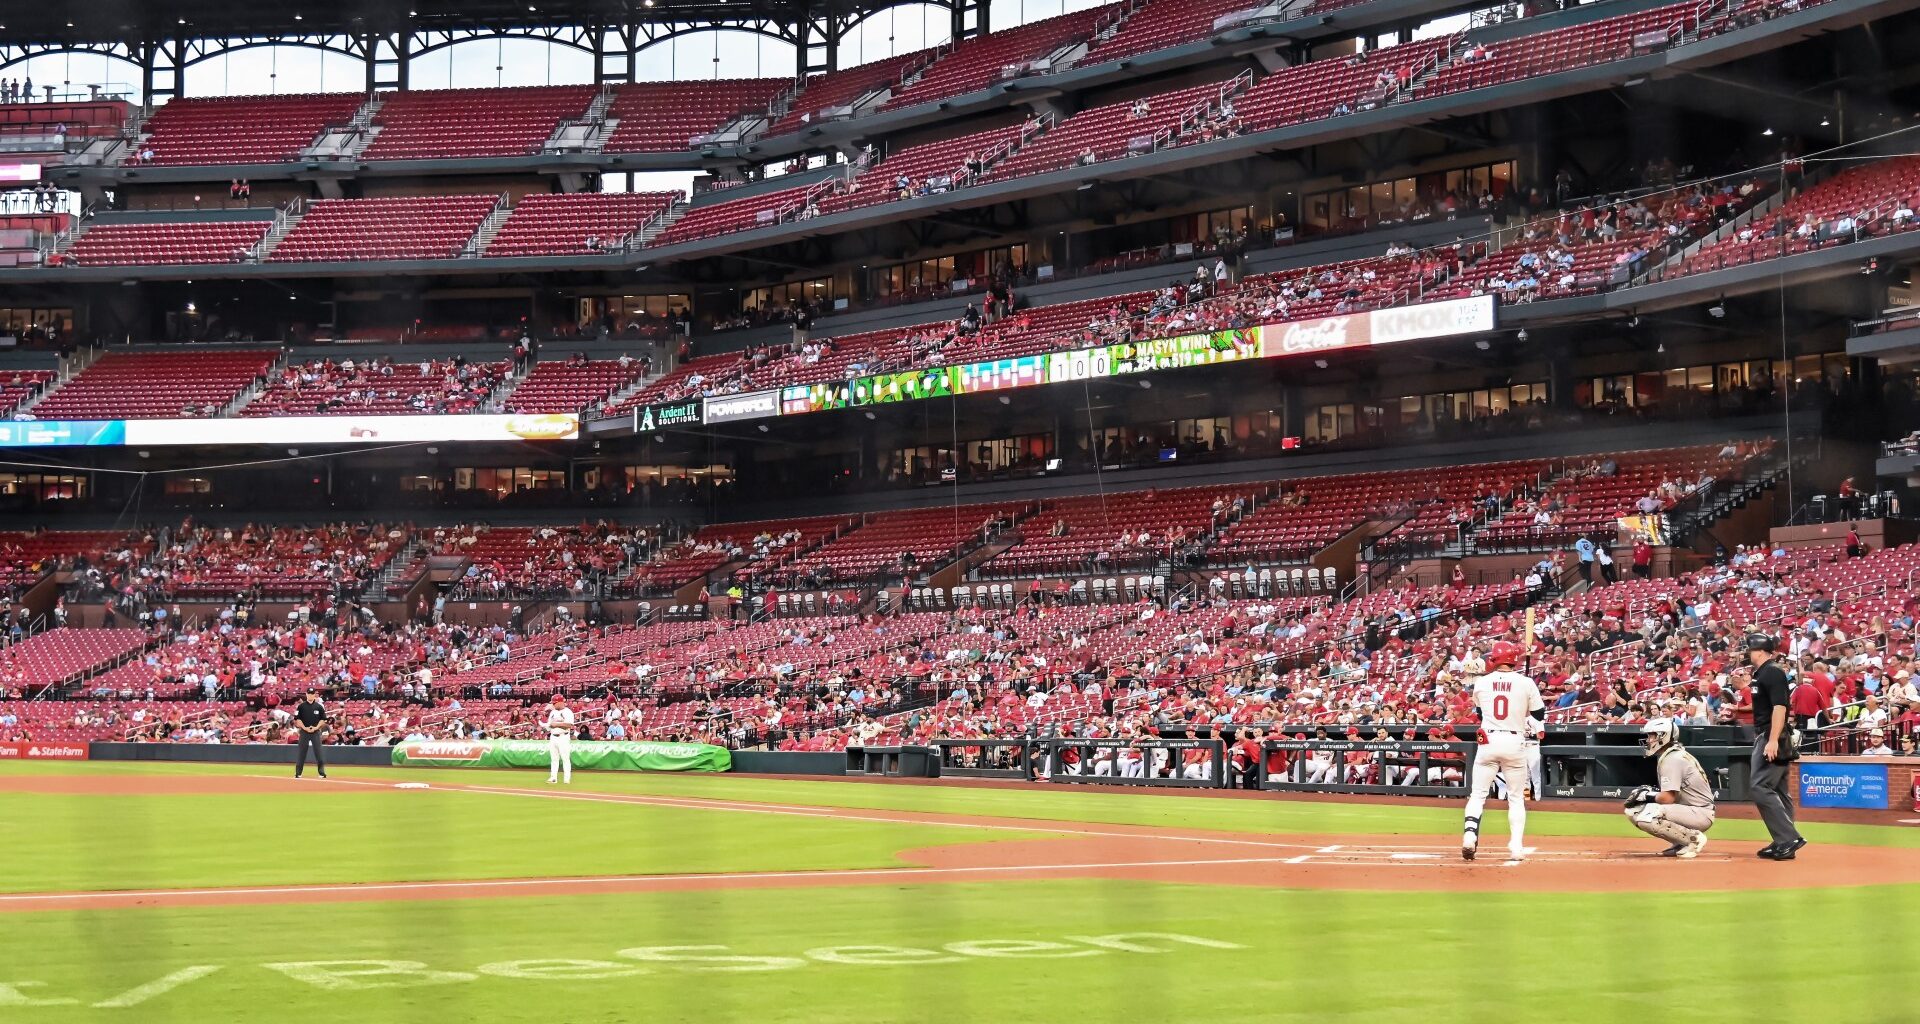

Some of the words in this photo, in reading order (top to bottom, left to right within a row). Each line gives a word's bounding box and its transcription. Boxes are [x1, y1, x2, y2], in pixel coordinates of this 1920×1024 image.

[1376, 306, 1455, 336] KMOX
[1137, 338, 1177, 357] MASYN
[1180, 334, 1211, 352] WINN
[1076, 360, 1084, 377] 0
[1097, 357, 1105, 374] 0
[659, 405, 686, 419] Ardent
[686, 403, 697, 416] IT
[658, 415, 696, 426] SOLUTIONS
[1492, 681, 1512, 693] WINN
[1494, 695, 1508, 721] 0
[1801, 773, 1856, 788] Community
[1556, 789, 1570, 797] Mercy
[1602, 790, 1617, 798] Mercy
